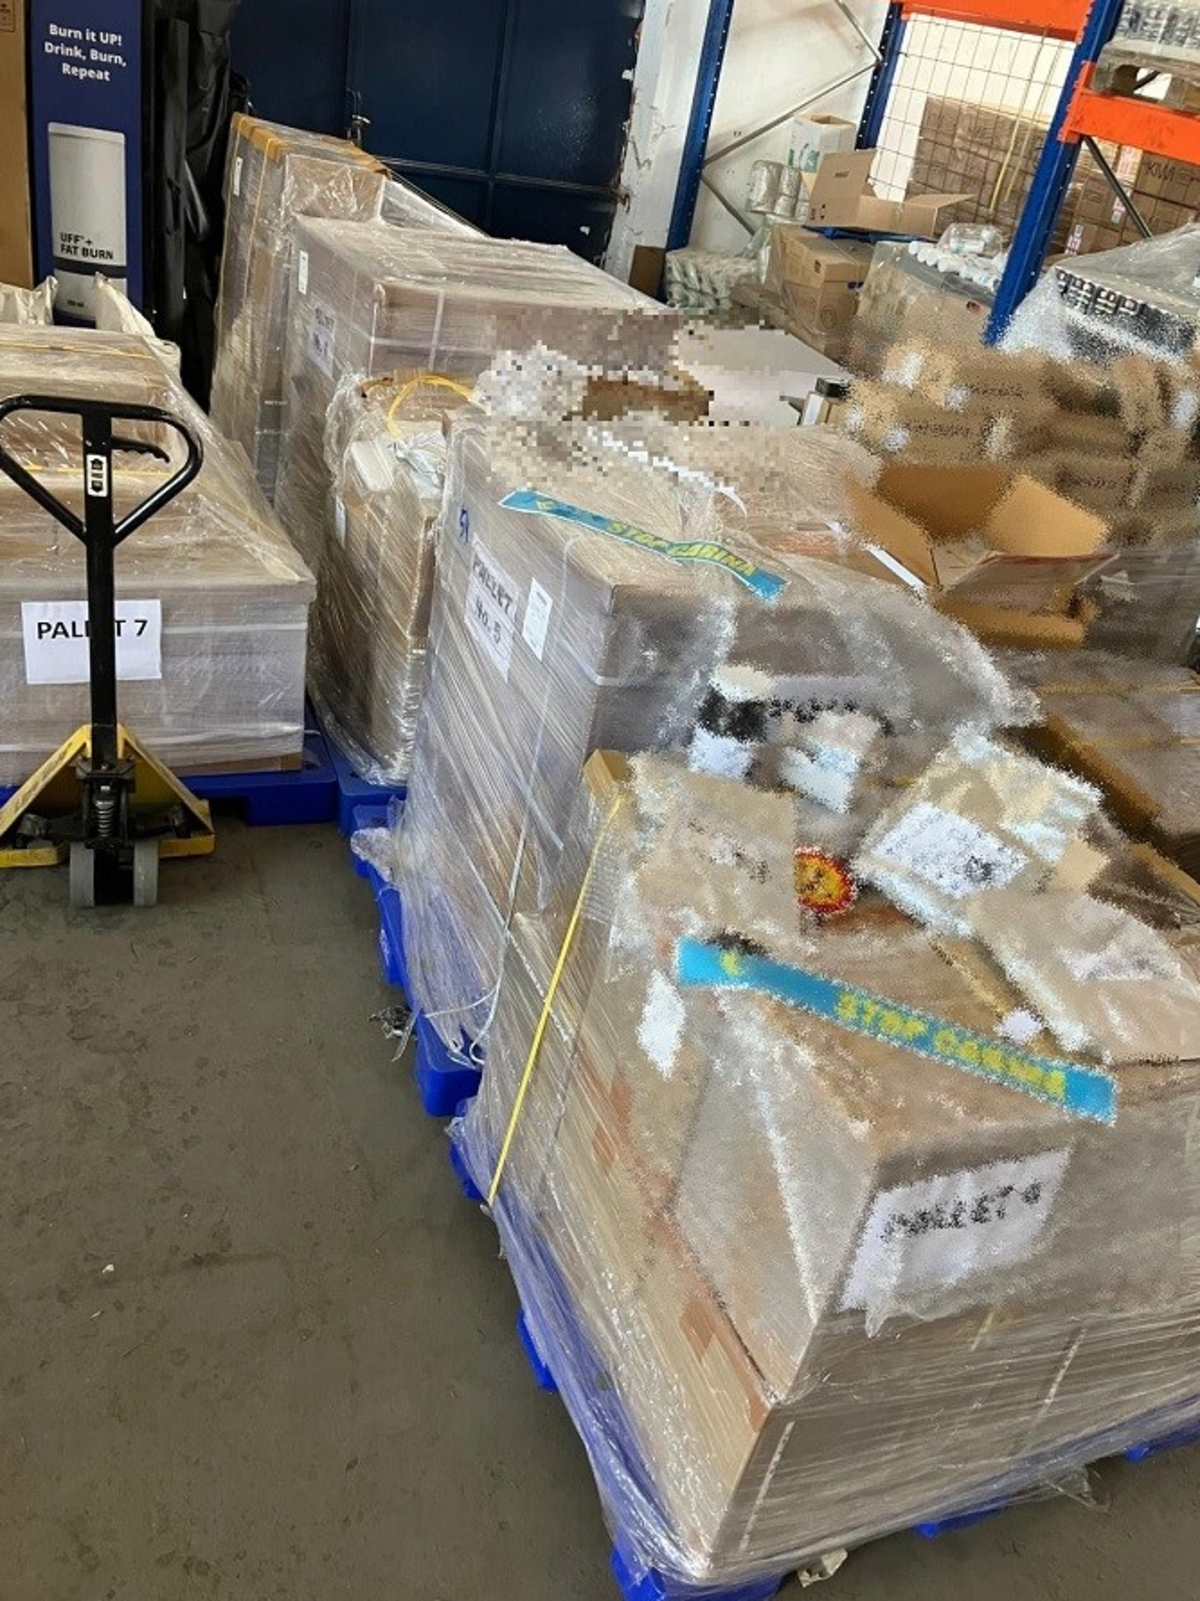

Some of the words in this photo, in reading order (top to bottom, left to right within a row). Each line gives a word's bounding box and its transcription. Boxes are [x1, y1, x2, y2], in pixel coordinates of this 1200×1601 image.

[49, 23, 82, 40] Burn
[86, 28, 96, 42] it
[100, 32, 122, 47] UP!
[44, 41, 87, 60] Drink,
[90, 48, 127, 67] Burn,
[62, 63, 111, 81] Repeat
[60, 243, 79, 255] FAT
[82, 247, 114, 259] BURN
[472, 556, 514, 616] PALLET
[37, 620, 126, 640] PALLT
[134, 619, 148, 637] 7
